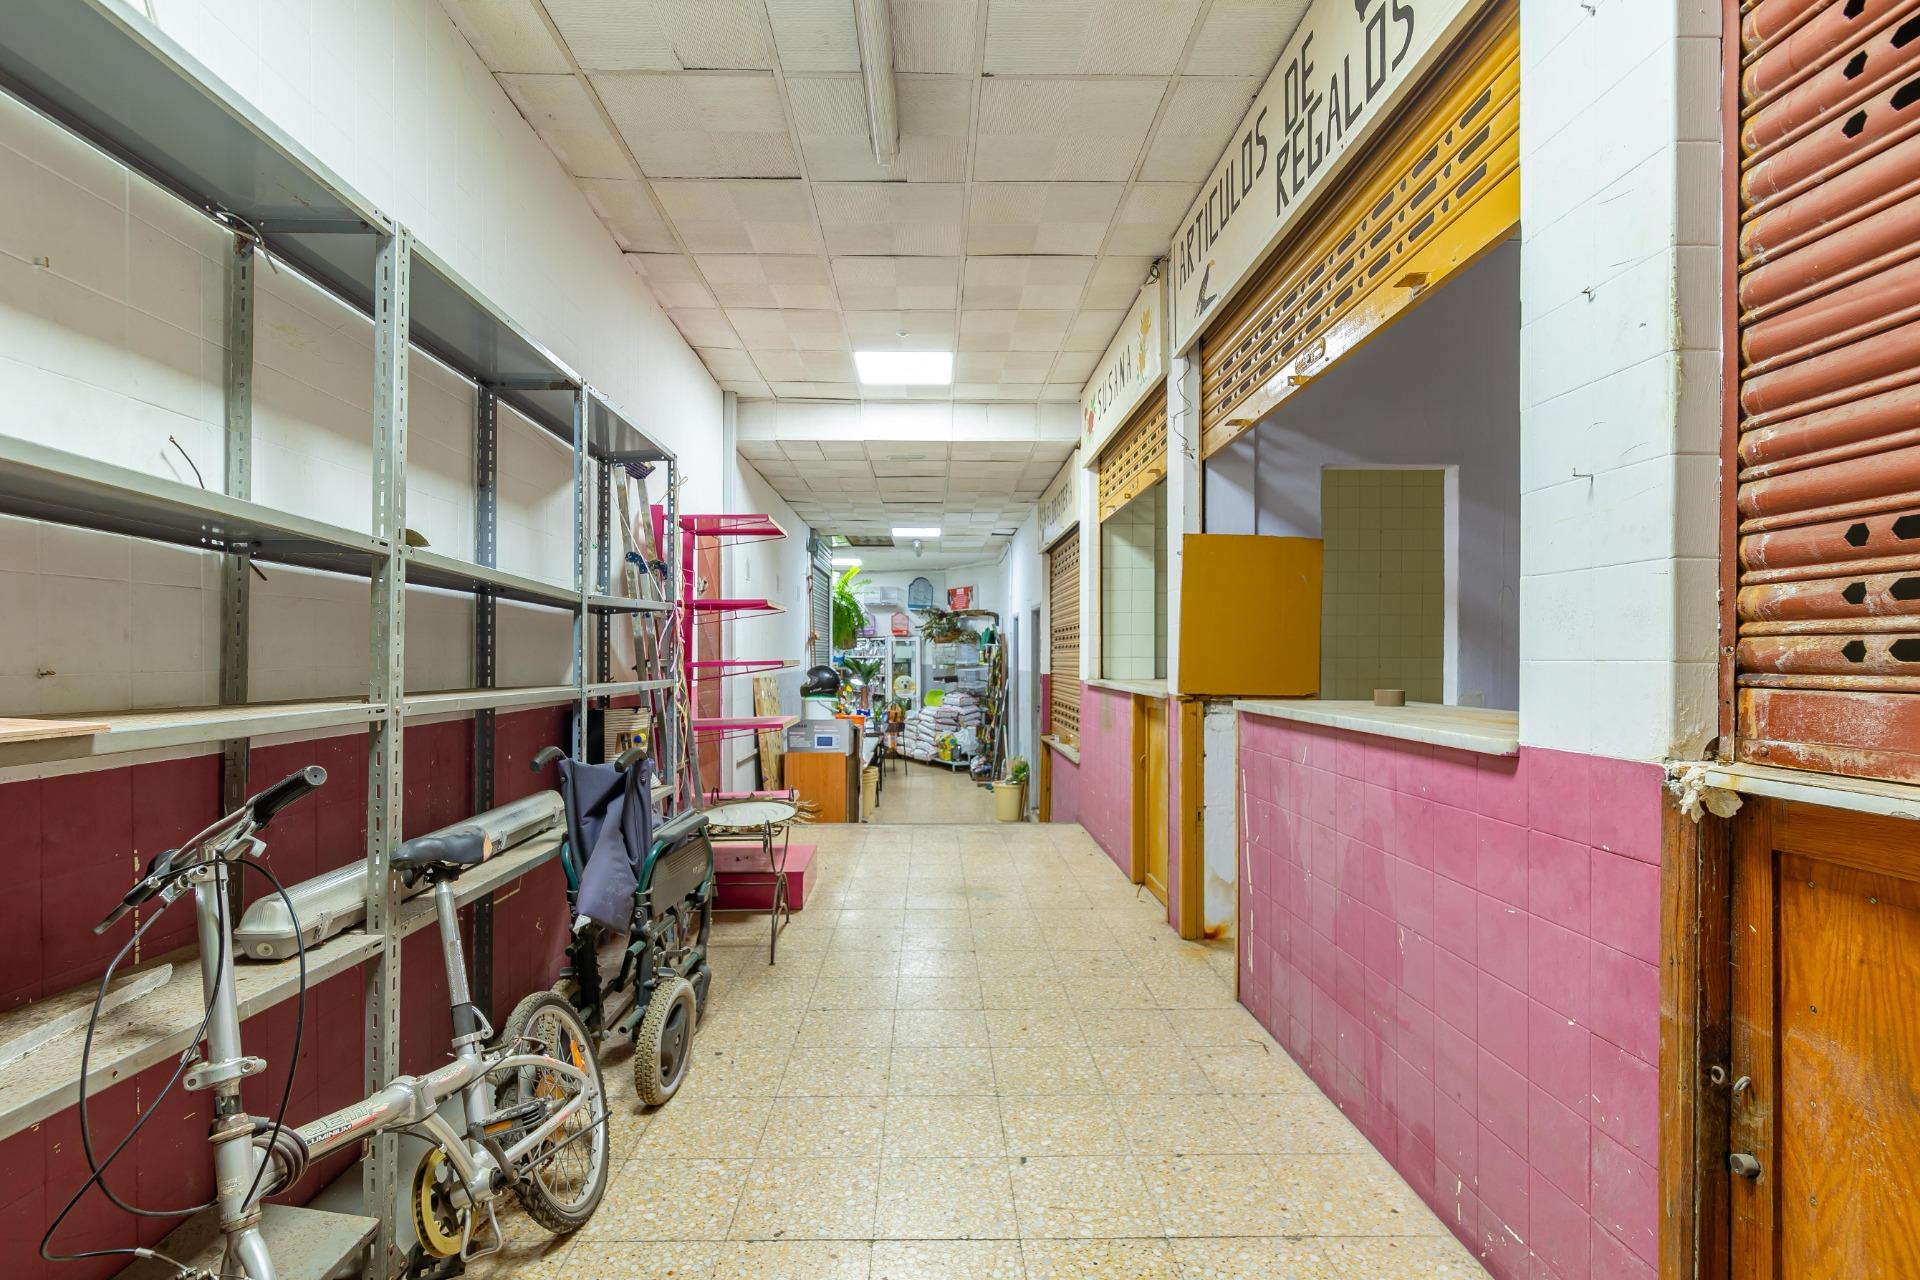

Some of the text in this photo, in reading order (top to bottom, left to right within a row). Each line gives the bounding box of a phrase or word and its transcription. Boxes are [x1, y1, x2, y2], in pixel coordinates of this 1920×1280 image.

[1179, 30, 1314, 291] ARTICULOS DE
[1276, 0, 1414, 218] REGALOS
[1097, 343, 1132, 421] SUSANA
[303, 1123, 353, 1147] LUMINIUM
